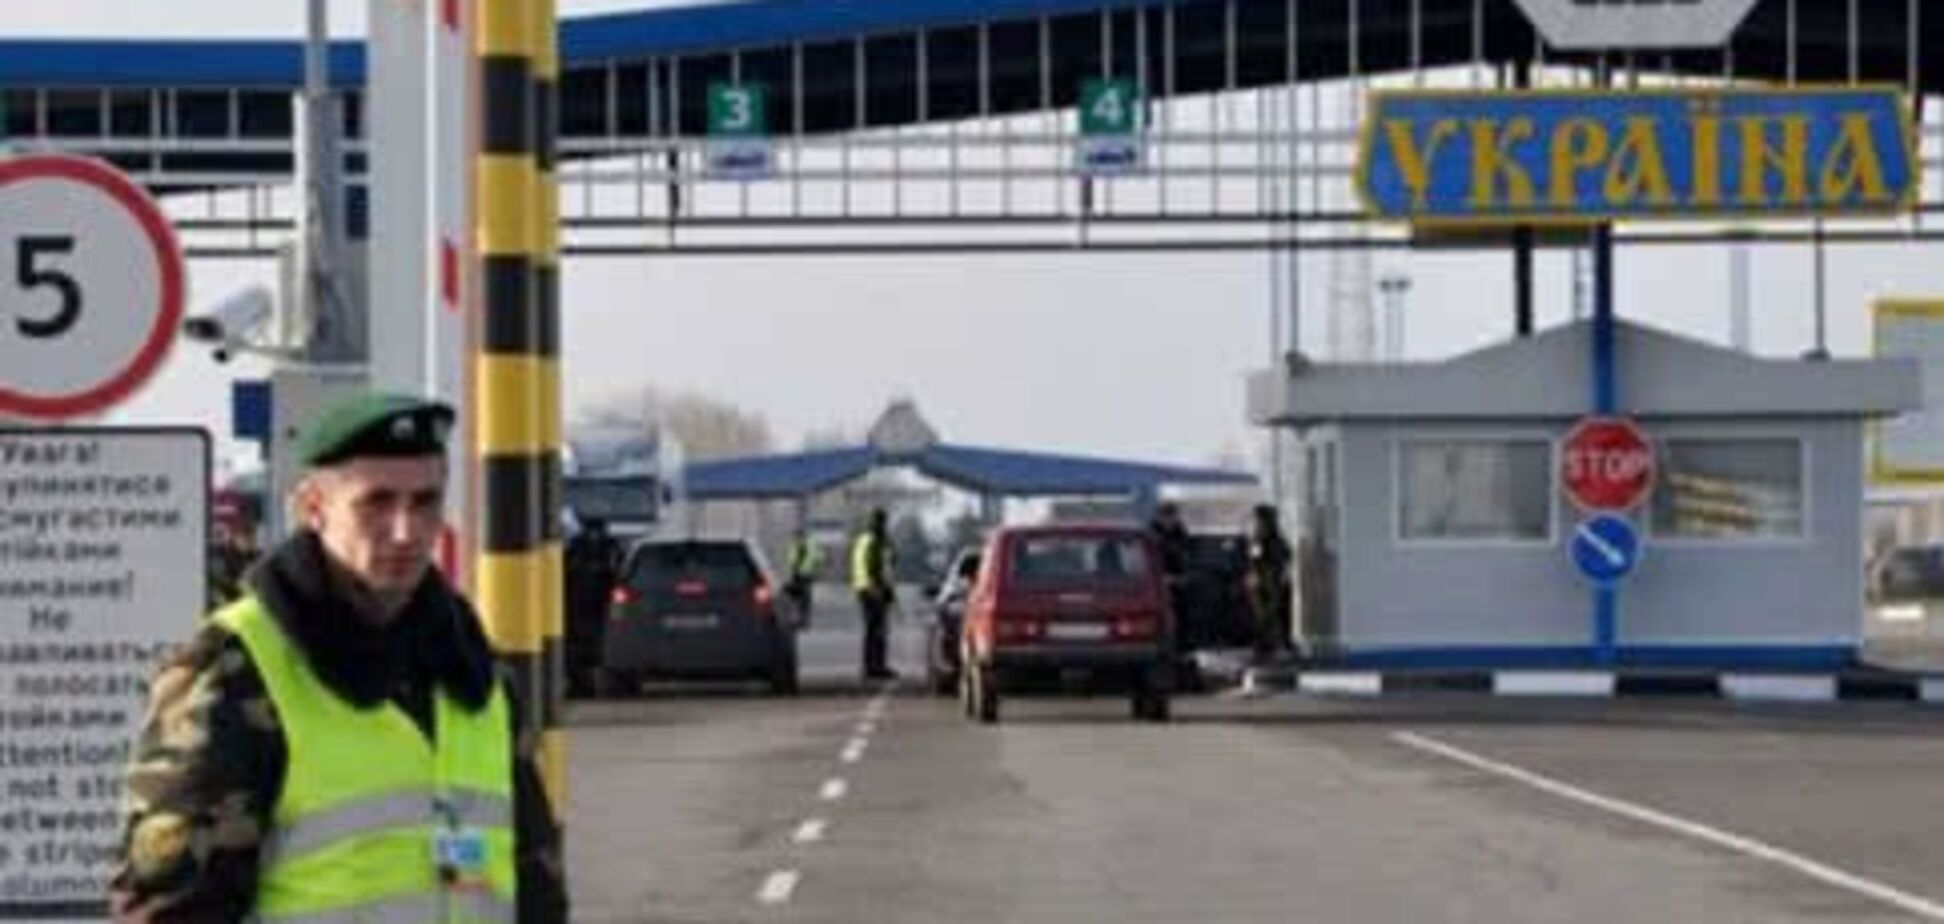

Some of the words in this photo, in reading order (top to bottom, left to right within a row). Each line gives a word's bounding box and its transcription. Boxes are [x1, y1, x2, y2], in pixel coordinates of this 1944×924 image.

[722, 91, 751, 129] 3
[1092, 87, 1124, 123] 4
[1384, 98, 1896, 208] УКРАЇНА
[17, 236, 82, 338] 5
[3, 441, 98, 464] Увага!
[1564, 449, 1651, 480] STOP
[29, 604, 71, 631] Не
